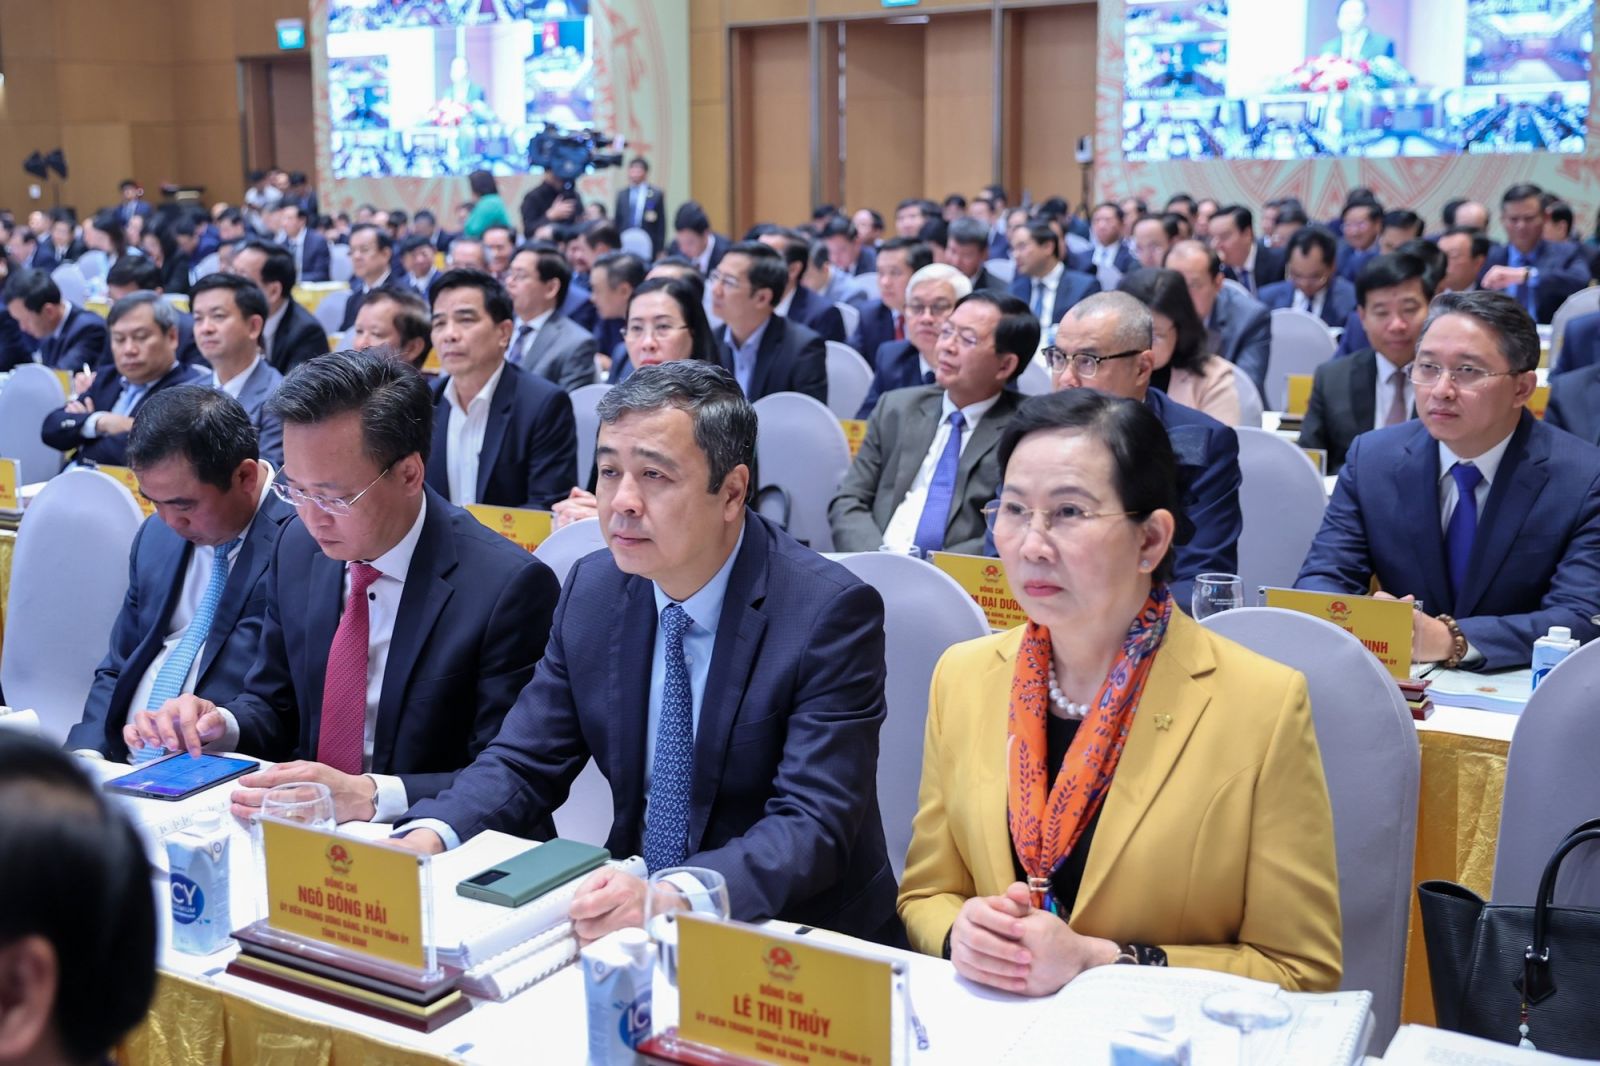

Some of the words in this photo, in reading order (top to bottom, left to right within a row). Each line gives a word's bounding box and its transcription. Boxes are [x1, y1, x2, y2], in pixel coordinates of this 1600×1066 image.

[982, 596, 997, 610] ĐẠI
[1000, 598, 1024, 612] DƯƠ
[298, 885, 323, 907] NGÔ
[365, 899, 387, 925] HẢI
[733, 993, 752, 1018] LÊ
[757, 1001, 783, 1030] THỊ
[788, 1008, 832, 1038] THỦY
